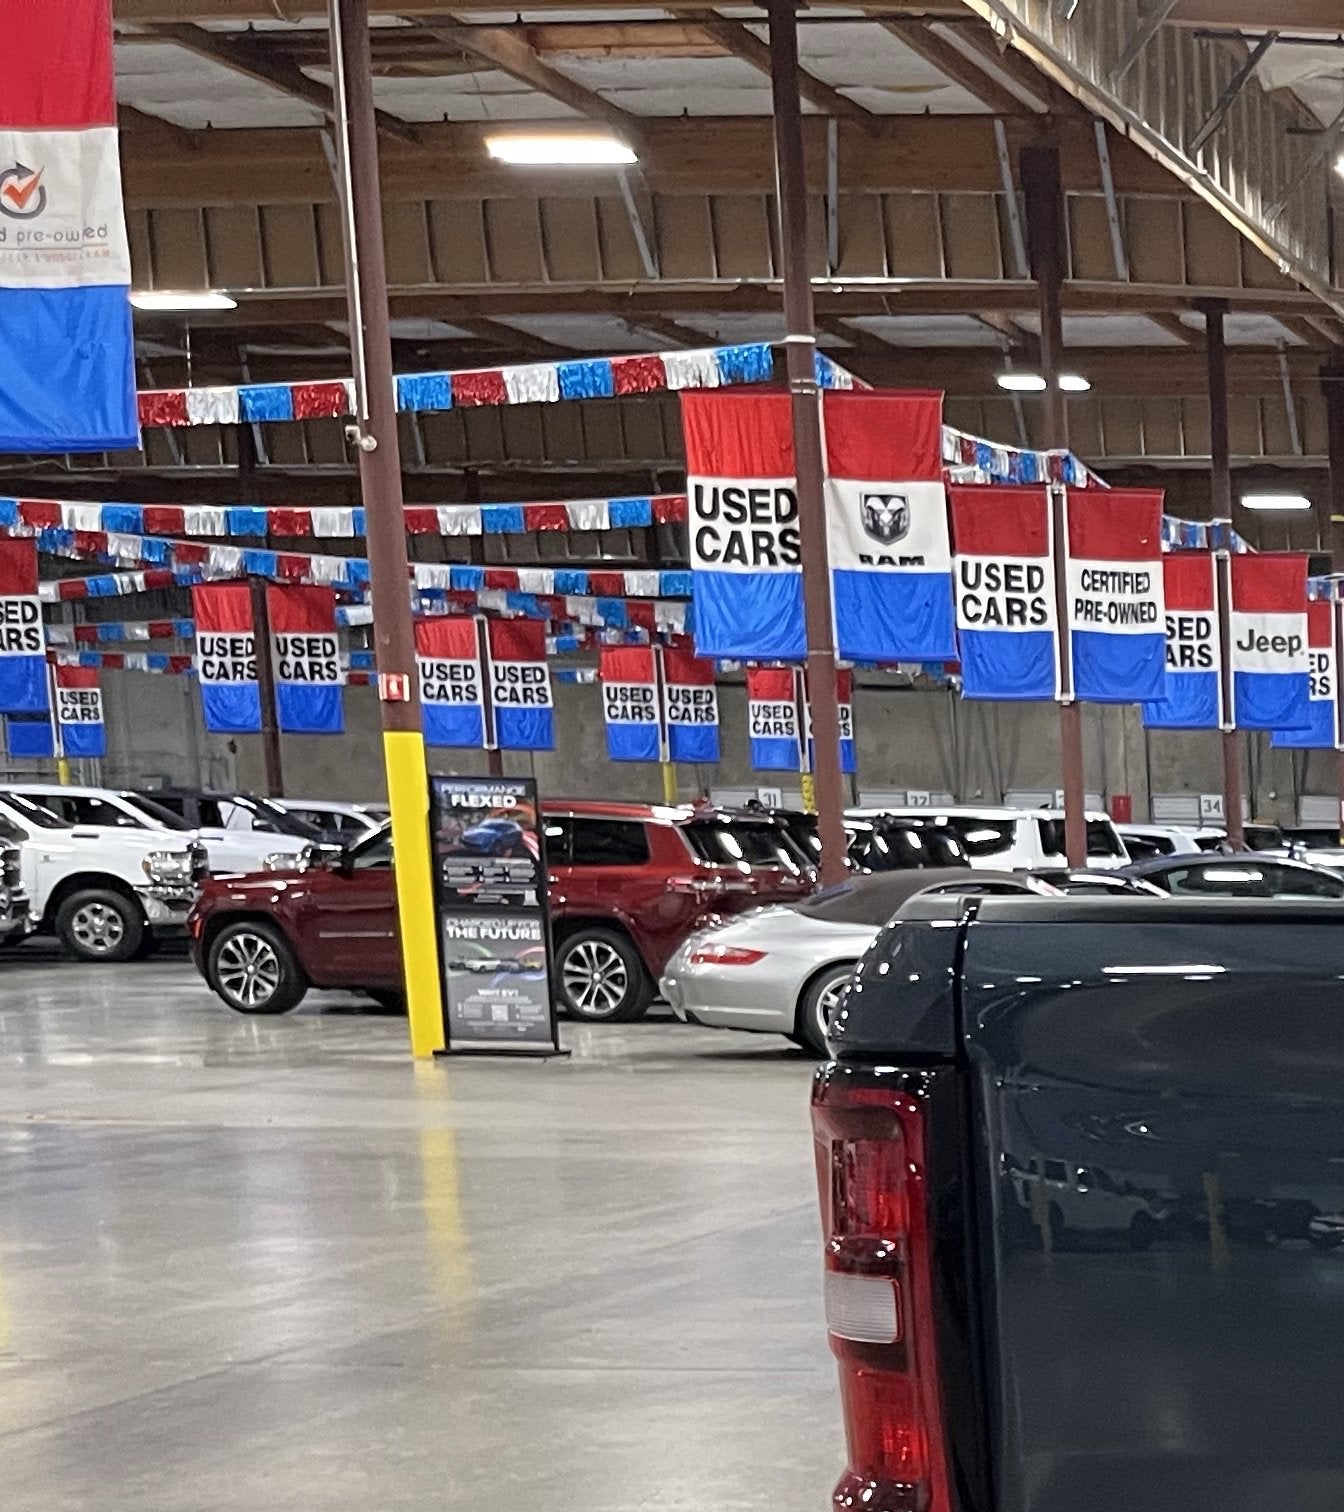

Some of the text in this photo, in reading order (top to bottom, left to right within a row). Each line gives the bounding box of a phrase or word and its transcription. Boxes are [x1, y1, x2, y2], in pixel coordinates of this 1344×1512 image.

[694, 484, 799, 525] USED
[695, 525, 800, 567] CARS
[858, 553, 925, 567] RAM
[961, 560, 1045, 594] USED
[1080, 568, 1151, 595] CERTIFIED
[0, 600, 38, 625] ED
[961, 593, 1048, 626] CARS
[1074, 598, 1158, 624] PRE-OWNED
[1166, 616, 1212, 641] SED
[0, 627, 41, 651] RS
[200, 636, 255, 658] USED
[276, 636, 336, 658] USED
[1236, 628, 1302, 658] Jeep
[1166, 643, 1213, 668] ARS
[202, 659, 257, 681] CARS
[279, 660, 338, 681] CARS
[421, 662, 476, 682] USED
[494, 665, 546, 684] USED
[60, 690, 99, 705] USED
[423, 683, 478, 702] CARS
[494, 685, 549, 704] CARS
[606, 686, 654, 703] USED
[668, 687, 714, 705] USED
[60, 706, 100, 721] CARS
[607, 704, 656, 721] CARS
[668, 705, 716, 722] CARS
[751, 704, 794, 719] USED
[752, 720, 795, 735] CARS
[451, 793, 517, 808] FLEXED
[1203, 800, 1221, 813] 34
[446, 927, 541, 940] THE FUTURE
